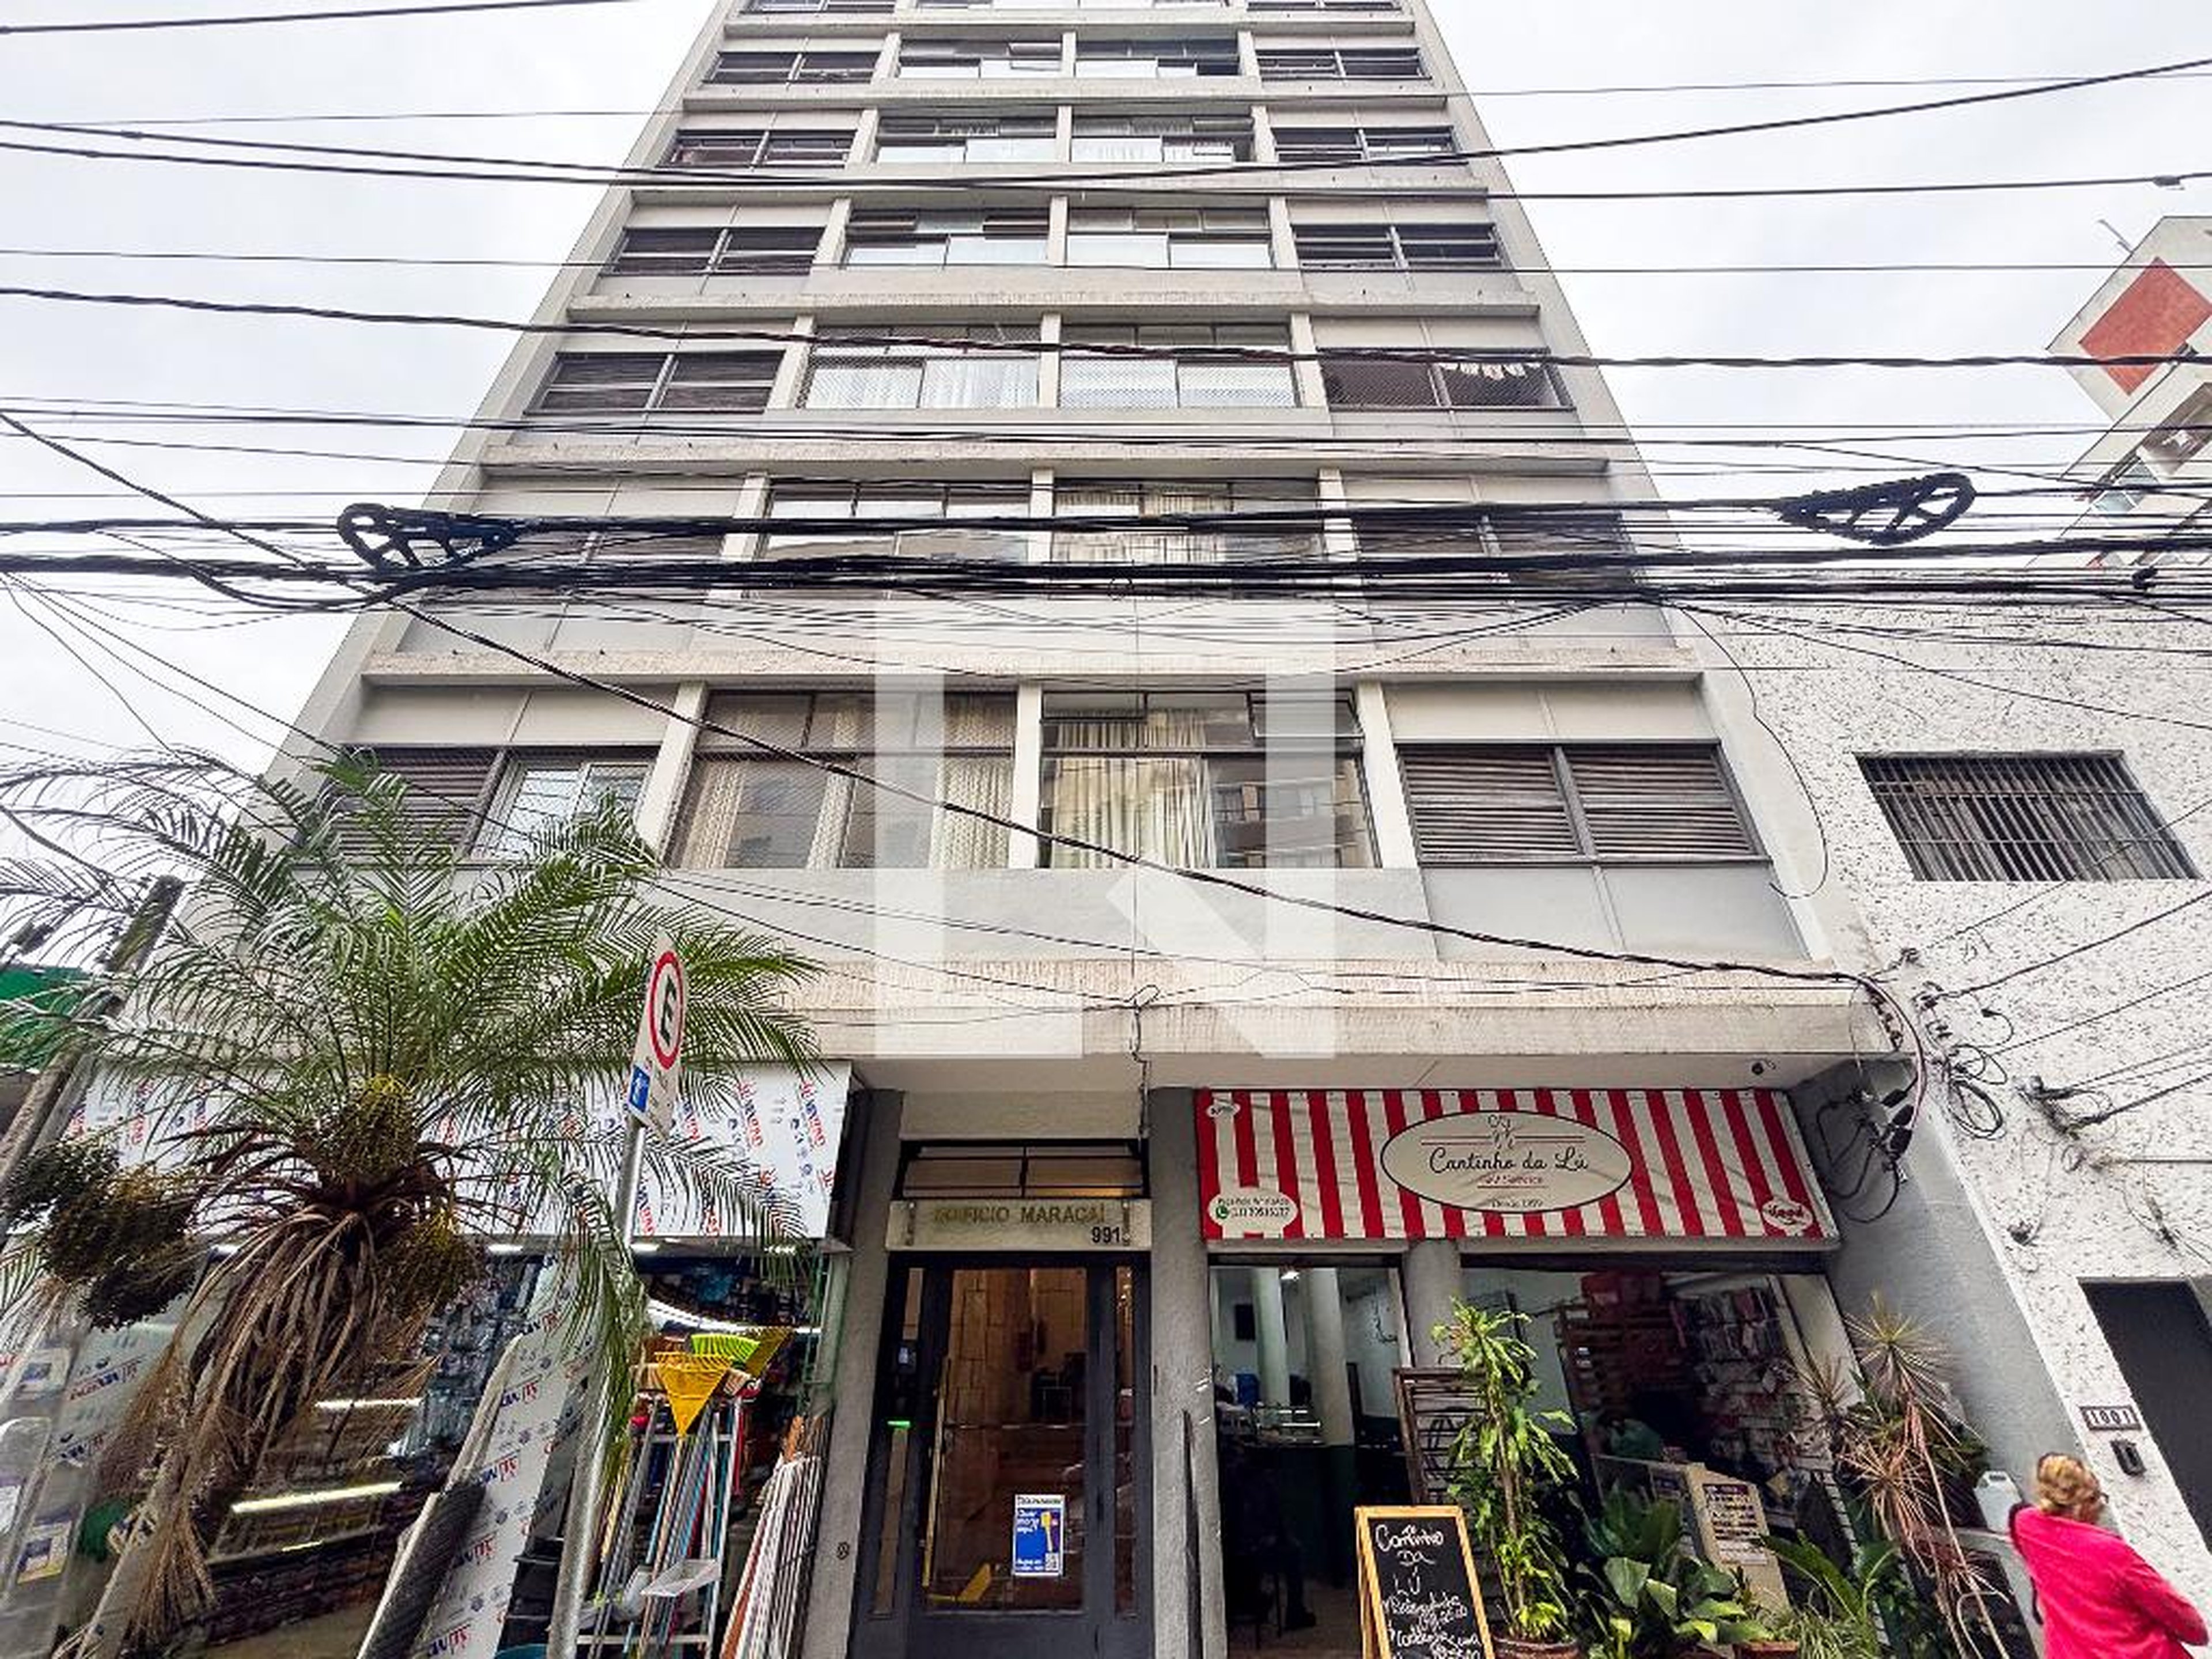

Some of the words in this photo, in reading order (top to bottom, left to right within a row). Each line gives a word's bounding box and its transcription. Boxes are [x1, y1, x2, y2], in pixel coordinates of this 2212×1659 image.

[1429, 1147, 1517, 1173] Cantinho
[1522, 1152, 1548, 1169] da
[1092, 1226, 1122, 1244] 991
[2090, 1410, 2131, 1425] 1001
